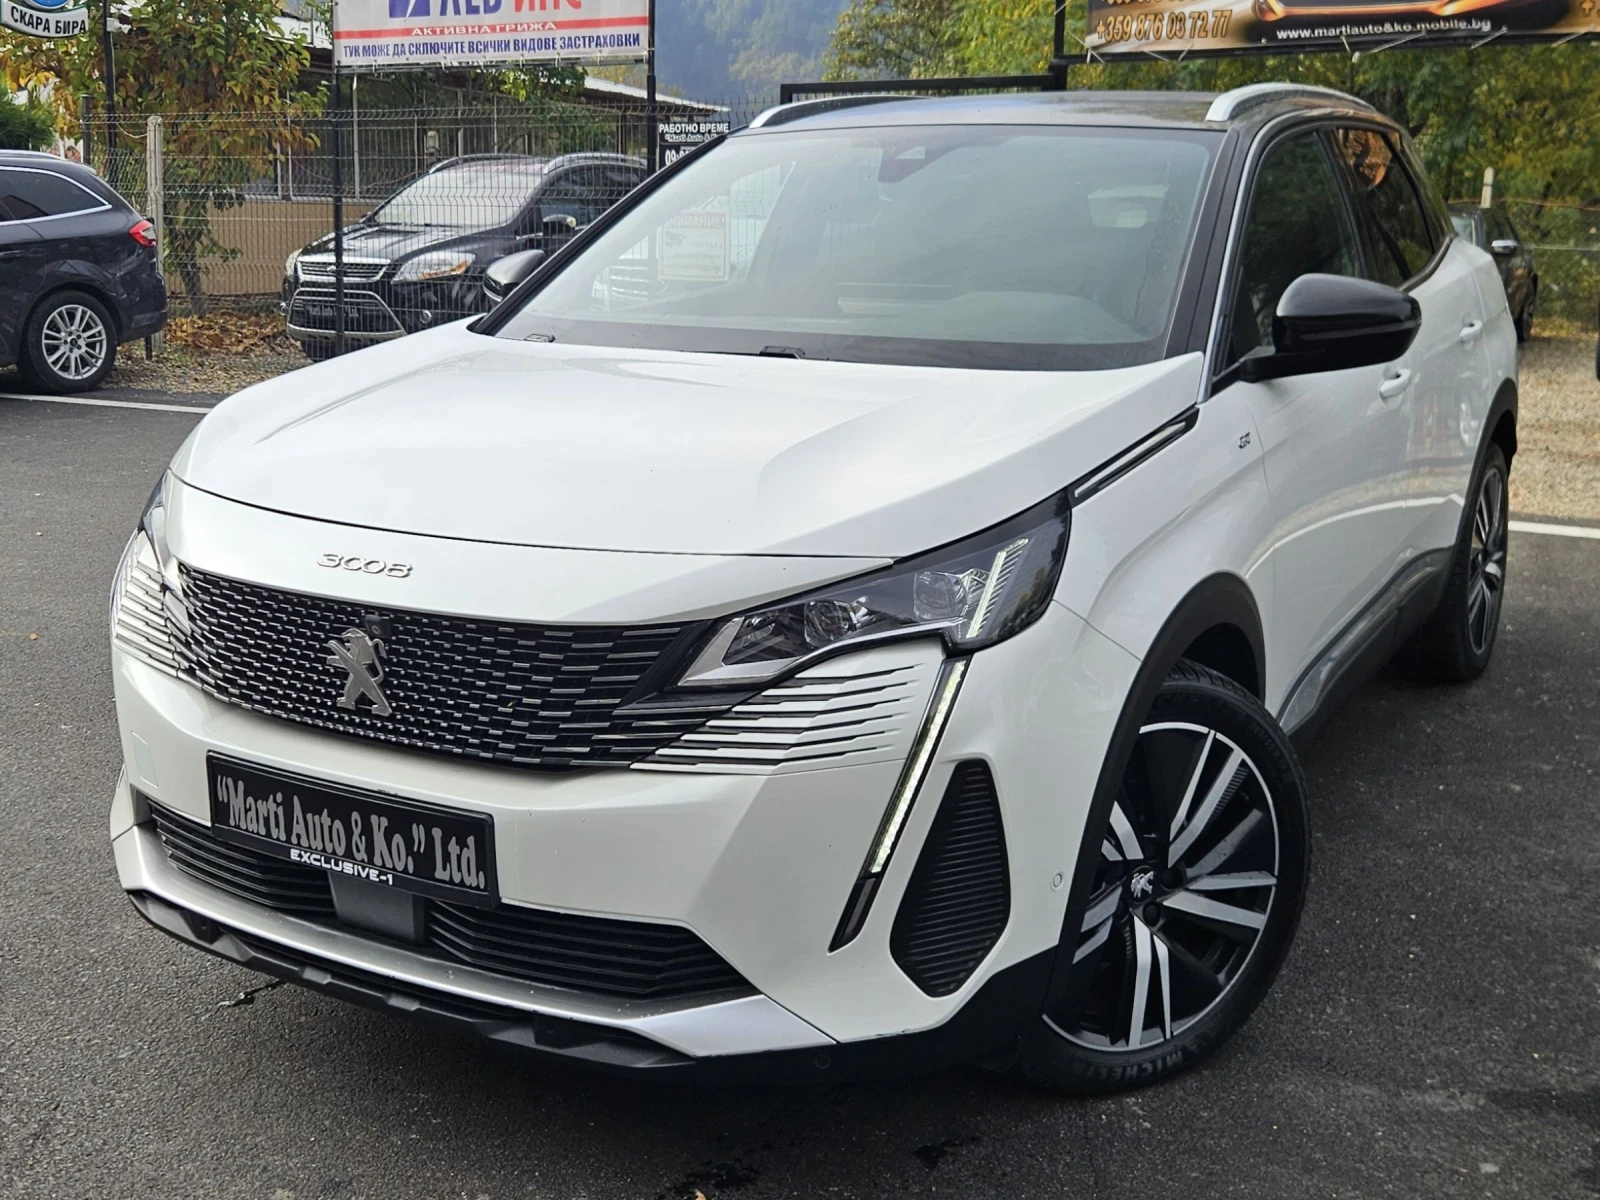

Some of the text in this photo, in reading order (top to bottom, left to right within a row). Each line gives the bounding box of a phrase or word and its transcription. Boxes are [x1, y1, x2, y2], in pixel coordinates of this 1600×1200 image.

[11, 6, 87, 34] СКАРА БИРА
[411, 22, 557, 36] АКТИВНА ГРИЖА
[1097, 10, 1232, 42] +359 876 03 72 77
[343, 33, 640, 58] ТУК МОЖЕ ДА СКЛЮЧИТЕ ВСИЧКИ ВИДОВЕ ЗАСТРАХОВКИ
[659, 123, 729, 133] РАБОТНО ВРЕМЕ
[318, 553, 413, 578] 3008
[217, 774, 287, 841] “Marti
[291, 795, 346, 856] Auto
[350, 811, 368, 862] &
[431, 827, 485, 889] Ltd.
[290, 848, 393, 886] EXCLUSIVE-1
